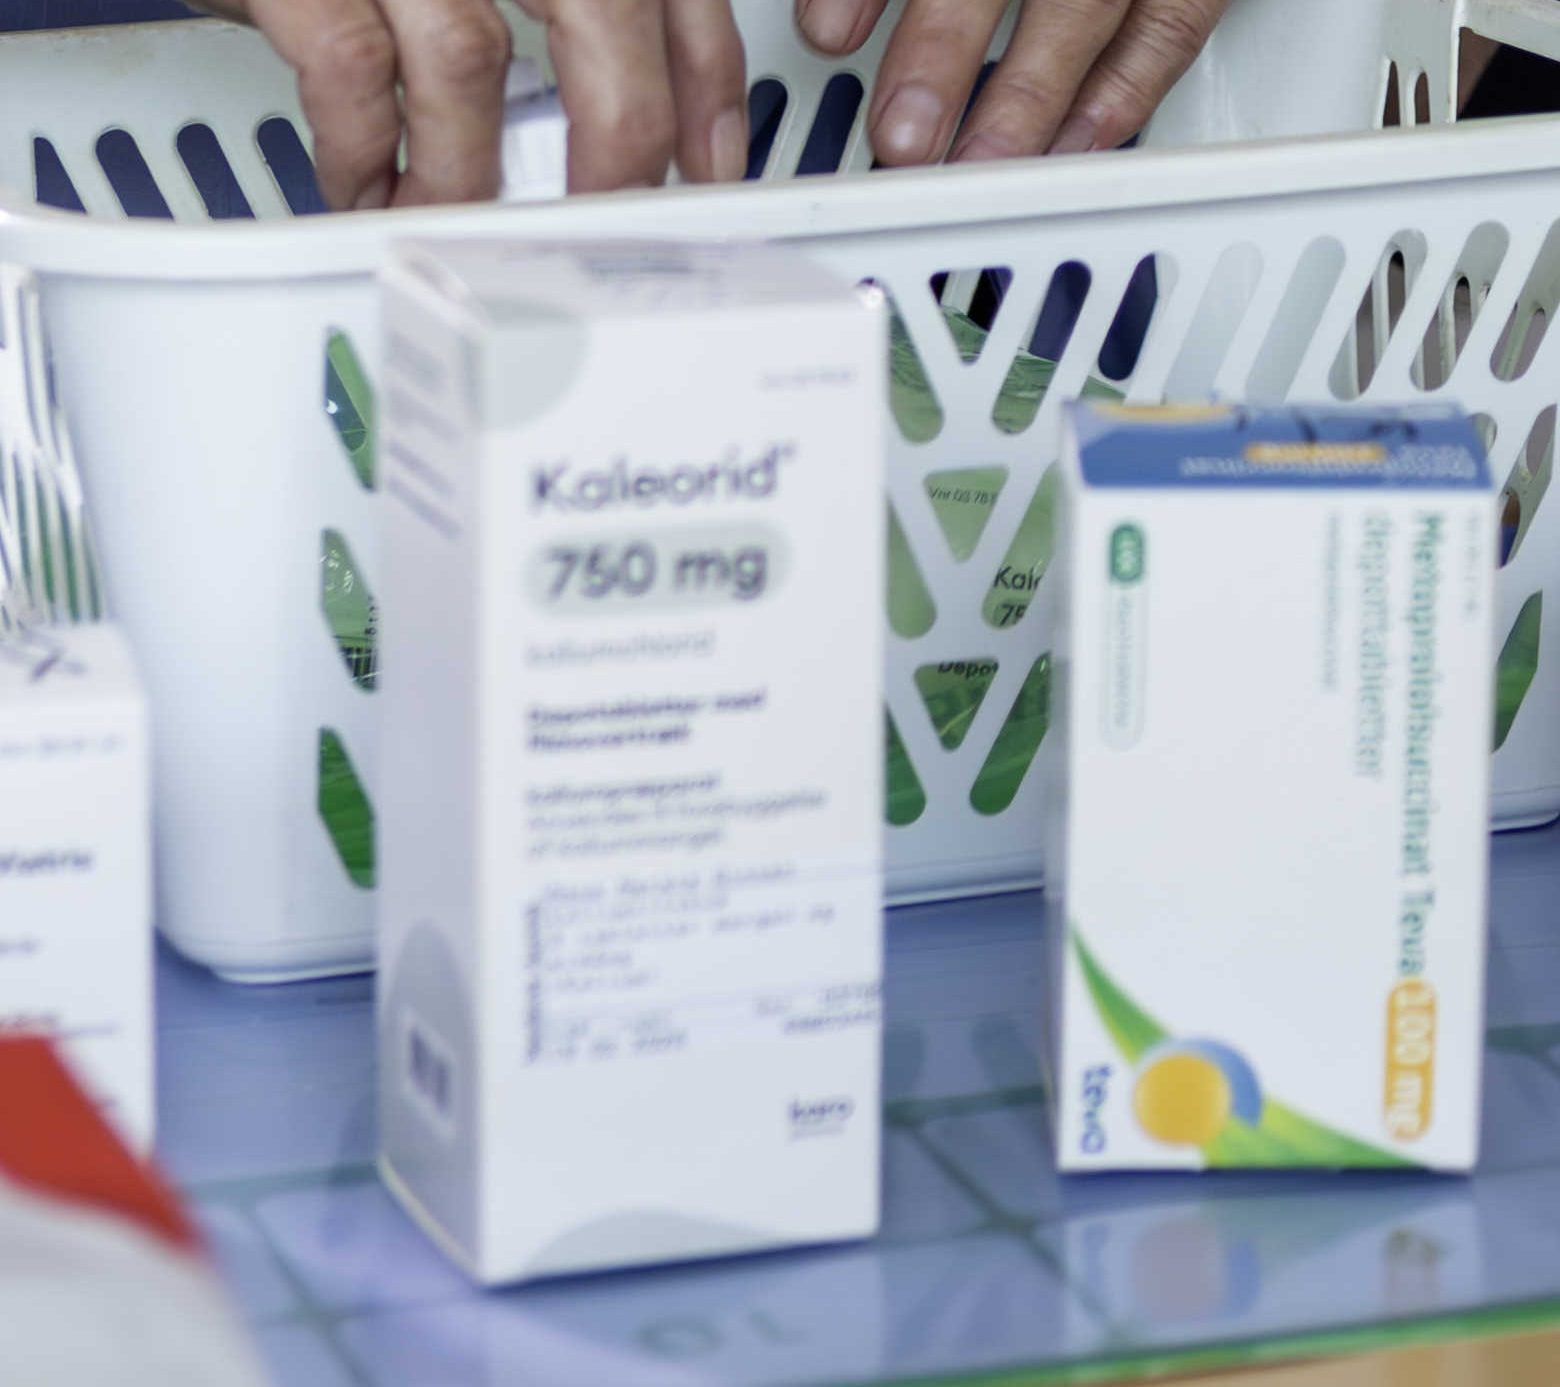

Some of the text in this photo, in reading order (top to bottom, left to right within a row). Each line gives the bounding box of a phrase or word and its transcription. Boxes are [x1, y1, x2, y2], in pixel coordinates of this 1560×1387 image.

[546, 540, 768, 602] 750 mg
[1400, 889, 1435, 977] Teva
[1082, 1066, 1113, 1154] teva
